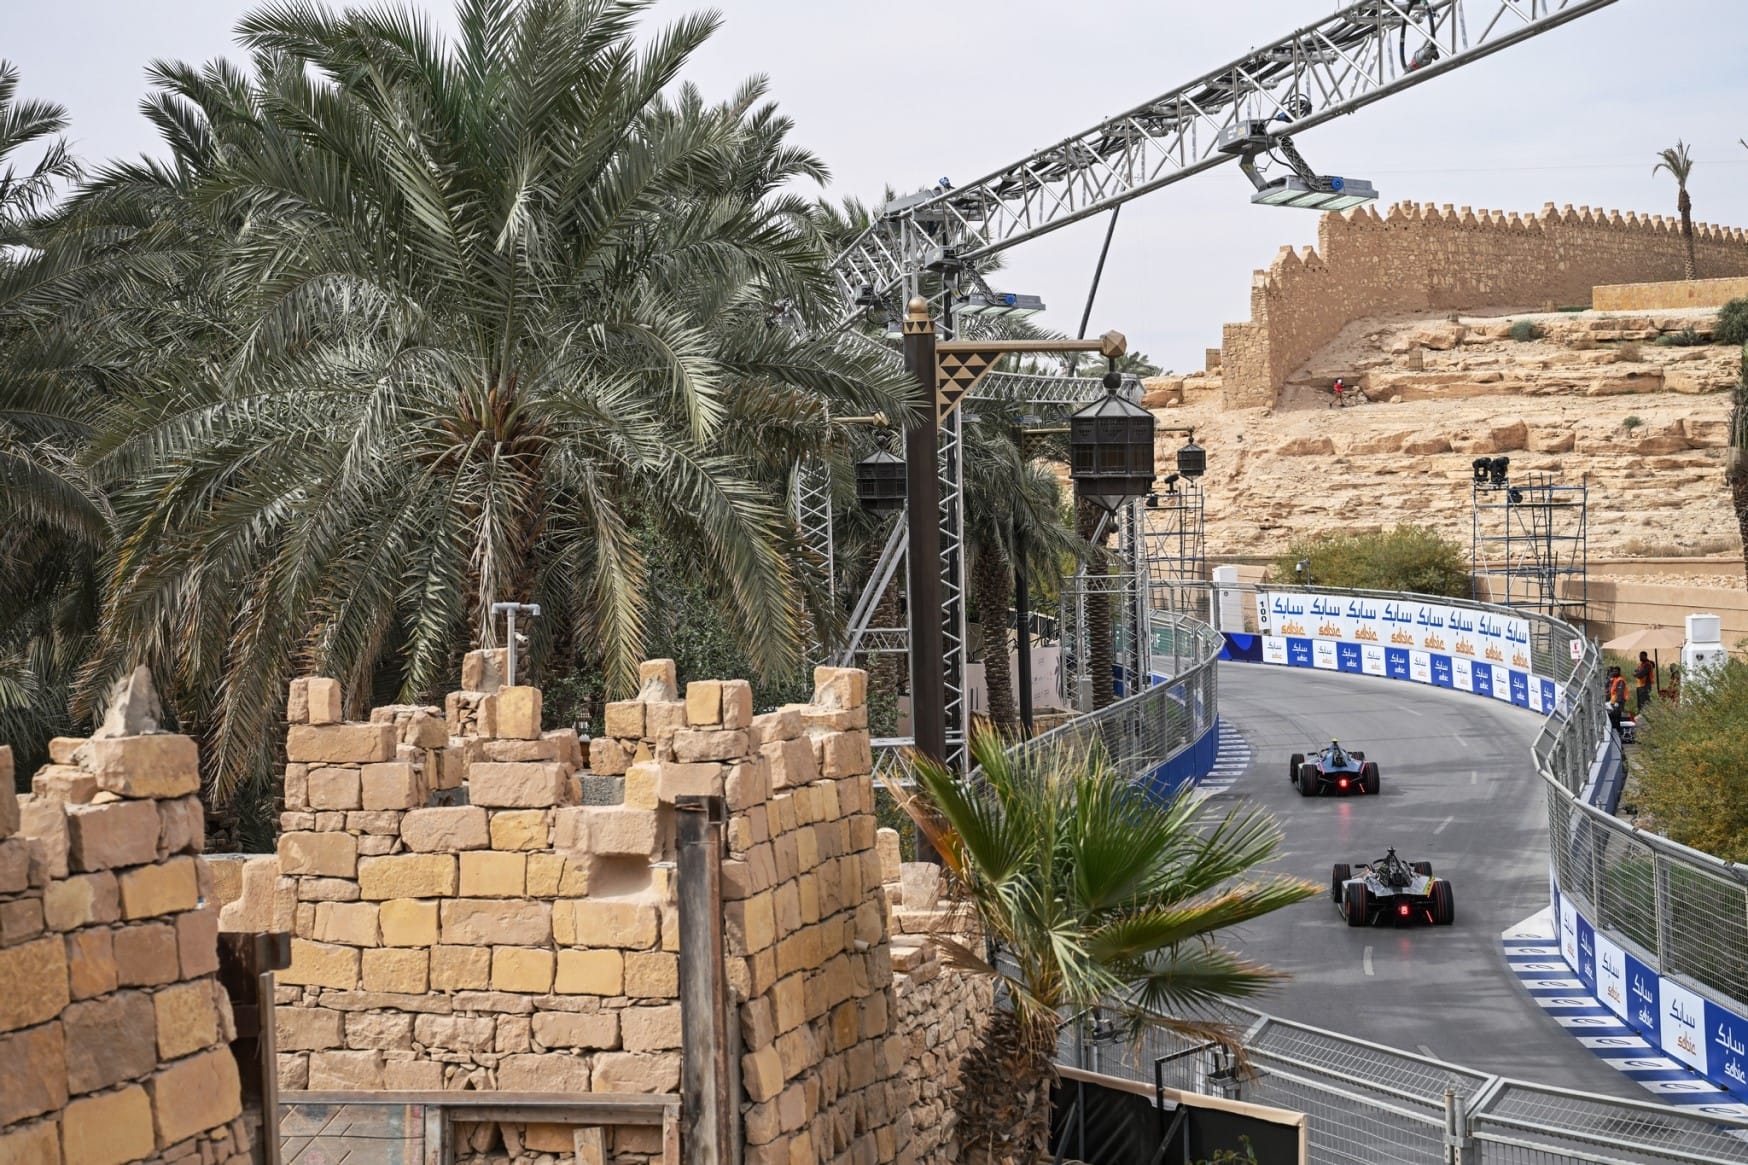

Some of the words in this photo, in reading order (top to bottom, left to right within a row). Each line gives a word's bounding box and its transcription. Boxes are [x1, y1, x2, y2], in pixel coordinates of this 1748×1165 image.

[1259, 601, 1267, 623] 100
[1273, 597, 1303, 619] سابك
[1310, 598, 1340, 620] سابك
[1346, 600, 1376, 623] سابك
[1382, 602, 1412, 627] سابك
[1417, 607, 1443, 631] سابك
[1281, 620, 1305, 635] sabic
[1319, 621, 1343, 637] sabic
[1355, 623, 1378, 641] sabic
[1449, 611, 1472, 635] سابك
[1478, 615, 1501, 641] سابك
[1506, 618, 1526, 647] سابك
[1391, 627, 1414, 645] sabic
[1425, 631, 1445, 650] sabic
[1456, 636, 1475, 655] sabic
[1486, 641, 1503, 662] sabic
[1512, 647, 1530, 669] sabic
[1633, 973, 1652, 1003] سابك
[1639, 1007, 1653, 1029] sabic
[1670, 999, 1695, 1028] سابك
[1677, 1031, 1696, 1056] sabic
[1715, 1023, 1744, 1056] سابك
[1724, 1058, 1746, 1084] sabic
